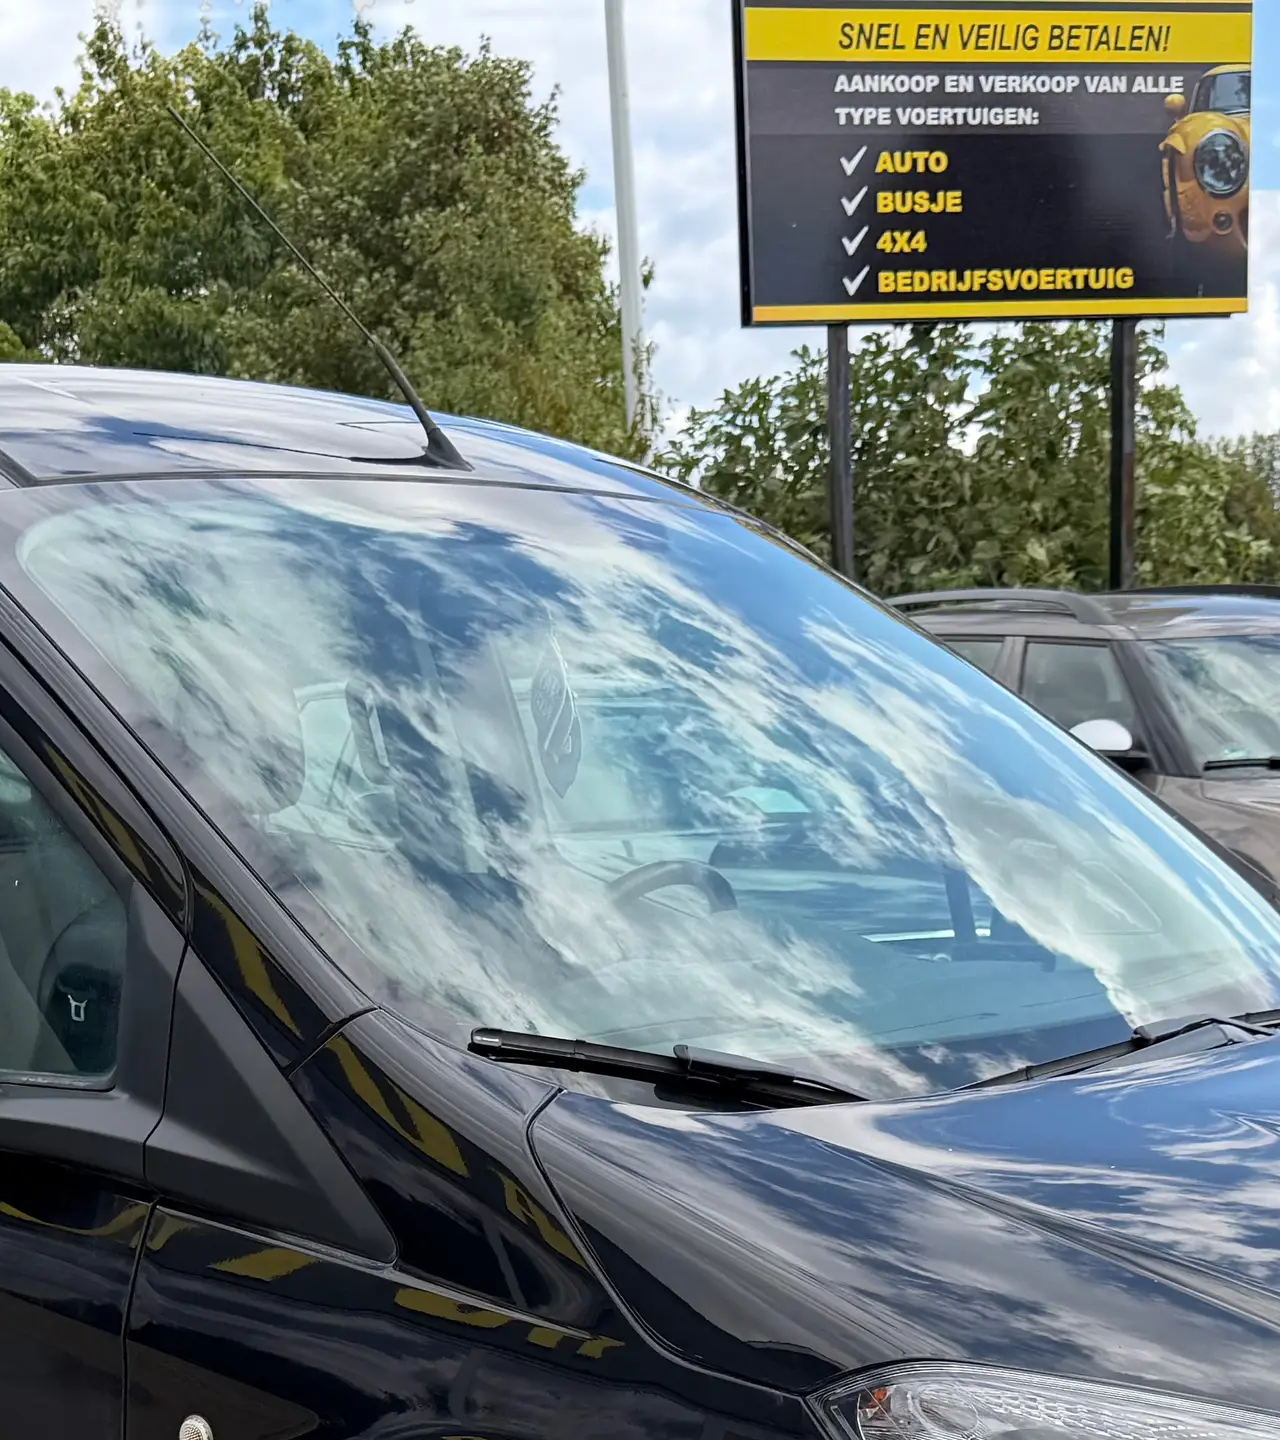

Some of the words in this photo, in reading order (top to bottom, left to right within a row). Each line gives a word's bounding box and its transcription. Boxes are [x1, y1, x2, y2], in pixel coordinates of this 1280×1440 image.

[838, 22, 906, 50] SNEL
[914, 23, 950, 50] EN
[958, 24, 1039, 51] VEILIG
[1047, 24, 1171, 52] BETALEN!
[834, 74, 940, 93] AANKOOP
[944, 75, 974, 93] EN
[978, 75, 1080, 93] VERKOOP
[1083, 75, 1128, 93] VAN
[1132, 76, 1184, 93] ALLE
[834, 107, 892, 126] TYPE
[895, 107, 1039, 126] VOERTUIGEN:
[875, 151, 948, 173] AUTO
[876, 191, 963, 214] BUSJE
[876, 231, 927, 253] 4X4
[877, 268, 1134, 293] BEDRIJFSVOERTUIG
